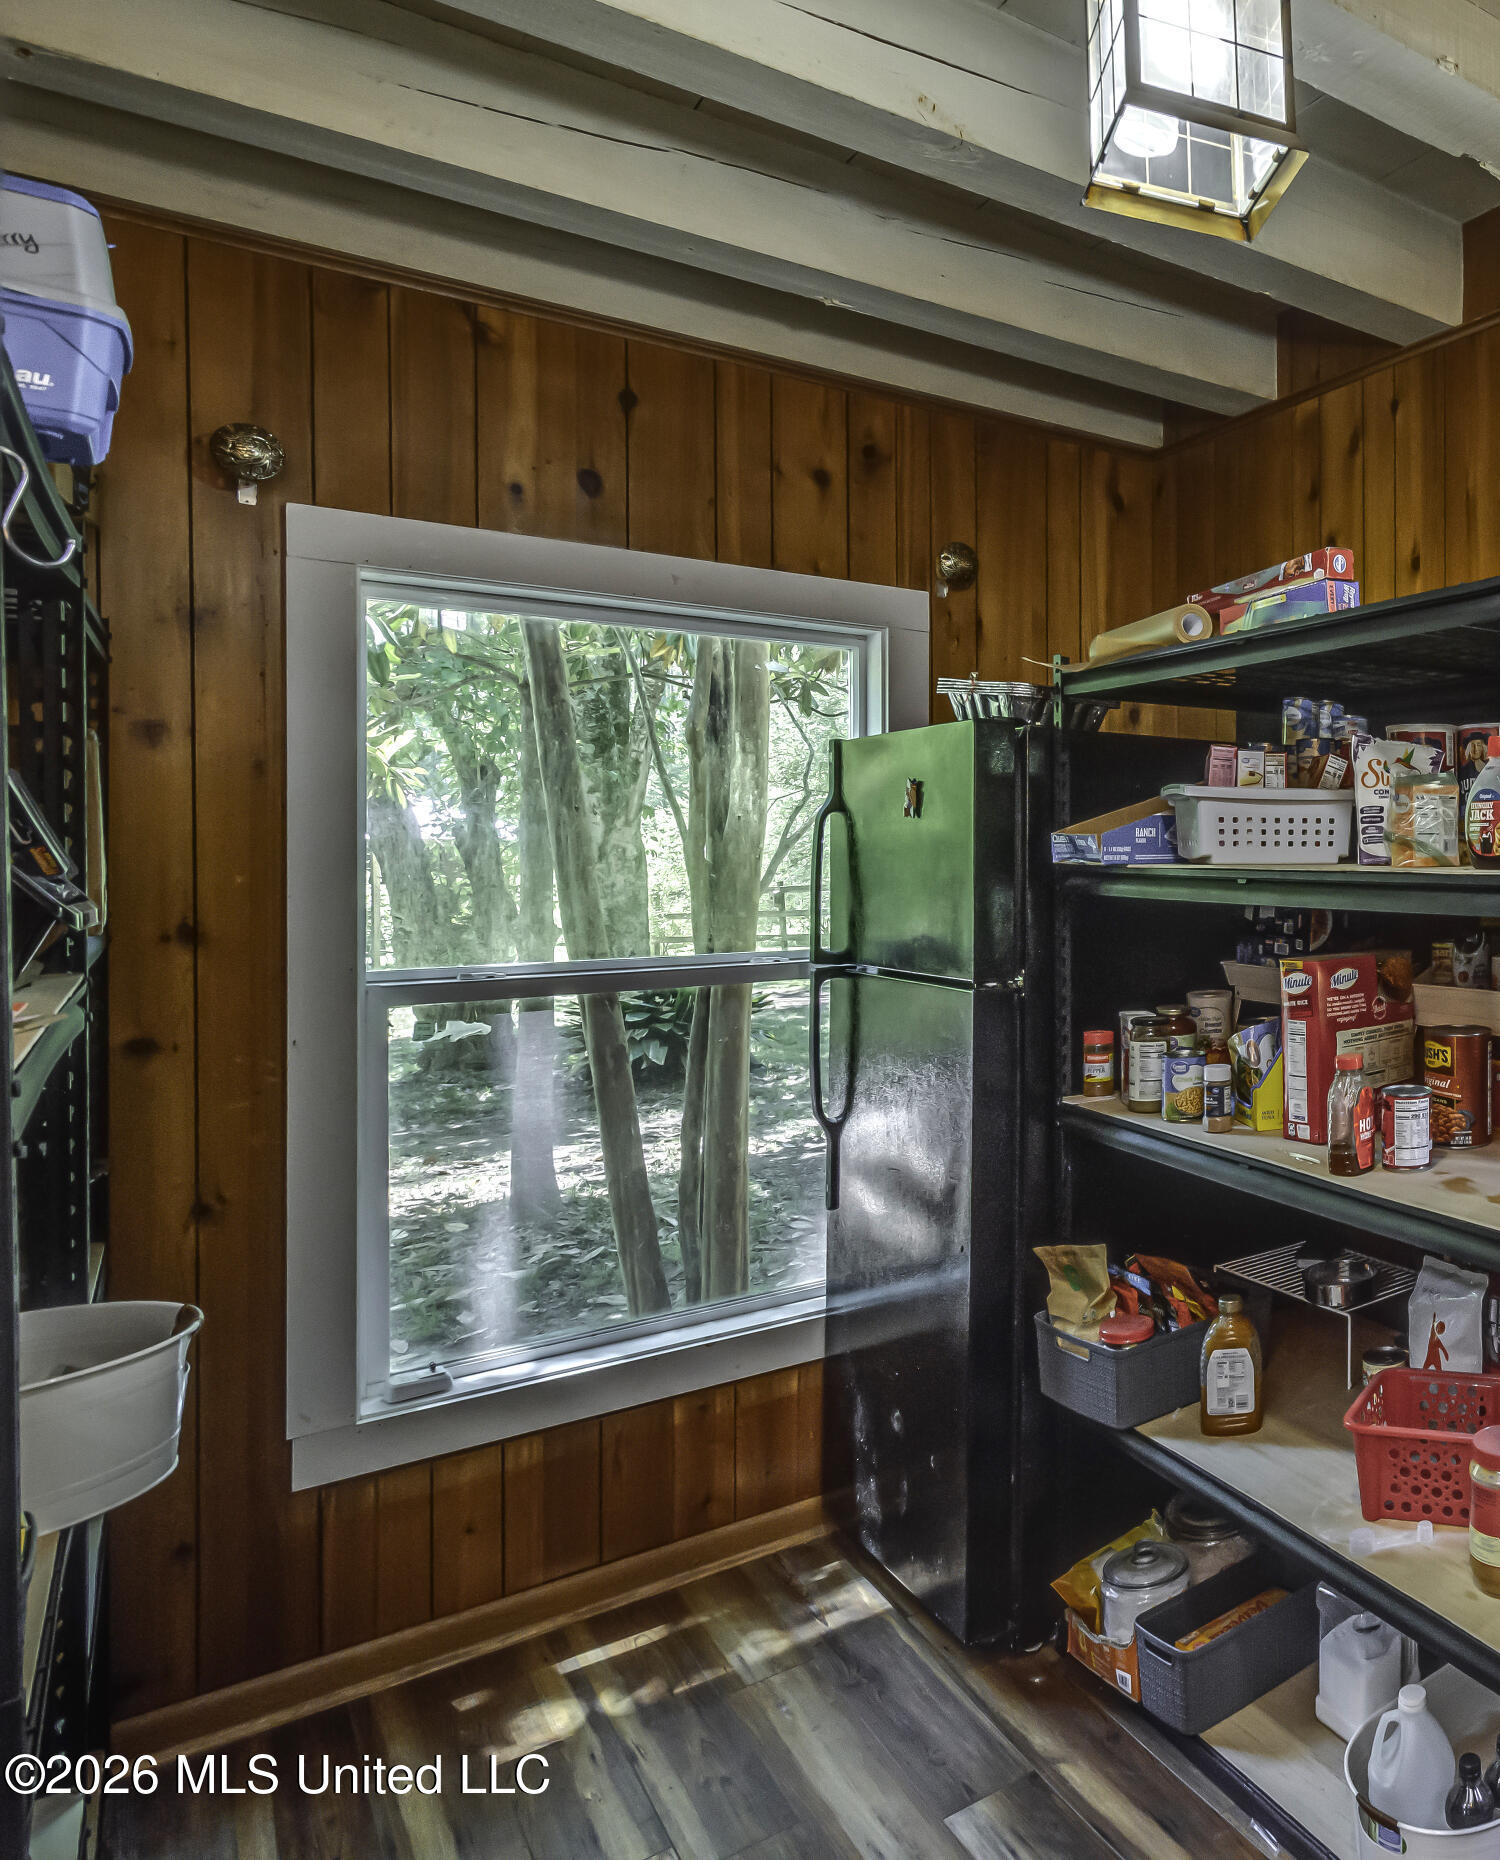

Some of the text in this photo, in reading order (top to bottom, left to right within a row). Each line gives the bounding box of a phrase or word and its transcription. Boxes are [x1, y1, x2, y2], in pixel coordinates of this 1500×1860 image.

[1469, 809, 1495, 821] JACK
[1135, 827, 1156, 838] RANCH
[1283, 975, 1313, 989] Minute
[1331, 969, 1359, 988] Minute
